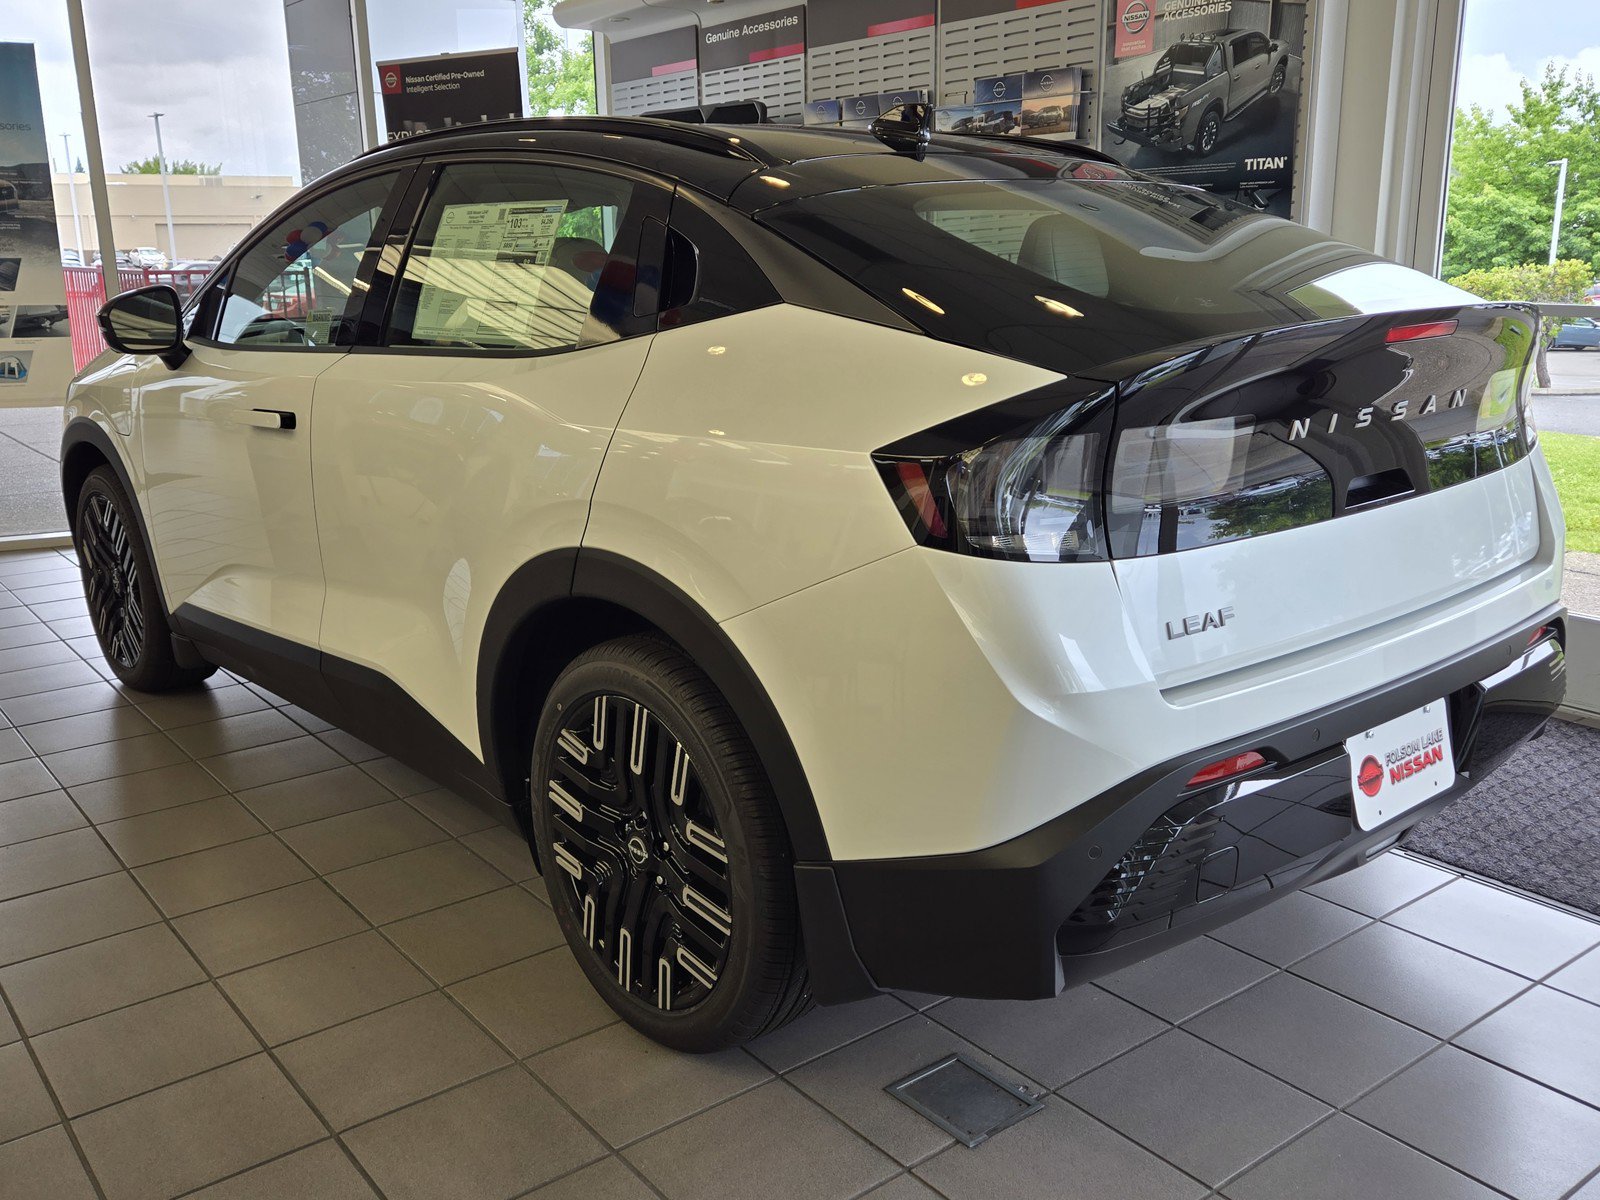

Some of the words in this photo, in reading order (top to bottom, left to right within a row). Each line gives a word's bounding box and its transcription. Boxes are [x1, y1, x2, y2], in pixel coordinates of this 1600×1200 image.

[1123, 12, 1148, 22] NISSAN
[1162, 2, 1232, 21] ACCESSORIES
[705, 28, 740, 44] Genuine
[742, 15, 798, 36] Accessories
[405, 75, 425, 84] Nissan
[425, 72, 450, 82] Certified
[451, 69, 485, 79] Pre-Owned
[406, 84, 434, 94] Intelligent
[434, 82, 461, 91] Selection
[510, 218, 522, 229] 103
[1288, 388, 1468, 442] NISSAN
[1165, 605, 1235, 641] LEAF
[1384, 738, 1420, 767] FOLSOM
[1421, 728, 1444, 750] LAKE
[1388, 743, 1444, 786] NISSAN
